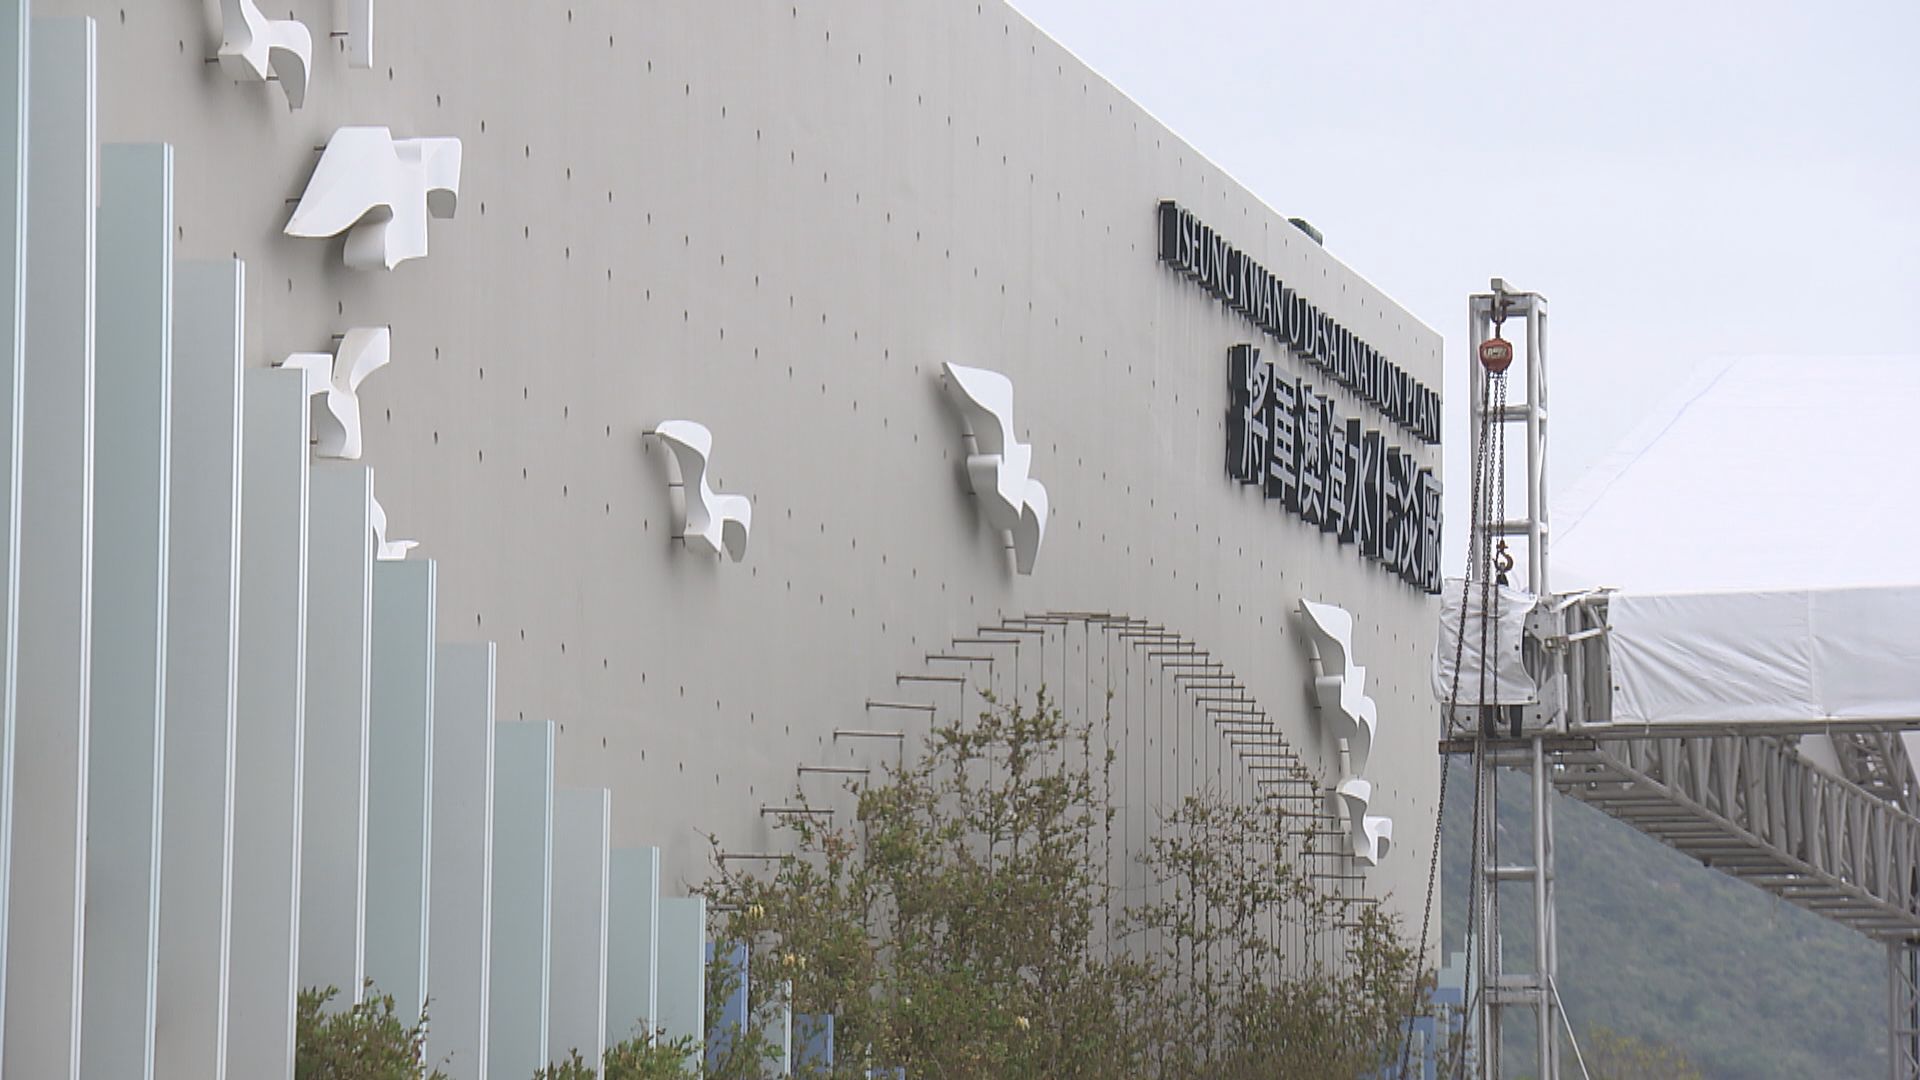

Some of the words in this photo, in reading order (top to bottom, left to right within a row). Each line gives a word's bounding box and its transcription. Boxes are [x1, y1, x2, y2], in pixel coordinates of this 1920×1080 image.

[1173, 203, 1235, 300] TSEUNG
[1240, 252, 1285, 336] KWAN
[1288, 287, 1301, 345] O
[1305, 301, 1401, 421] DESALINATION
[1241, 346, 1443, 592] 將軍澳海水化淡廠
